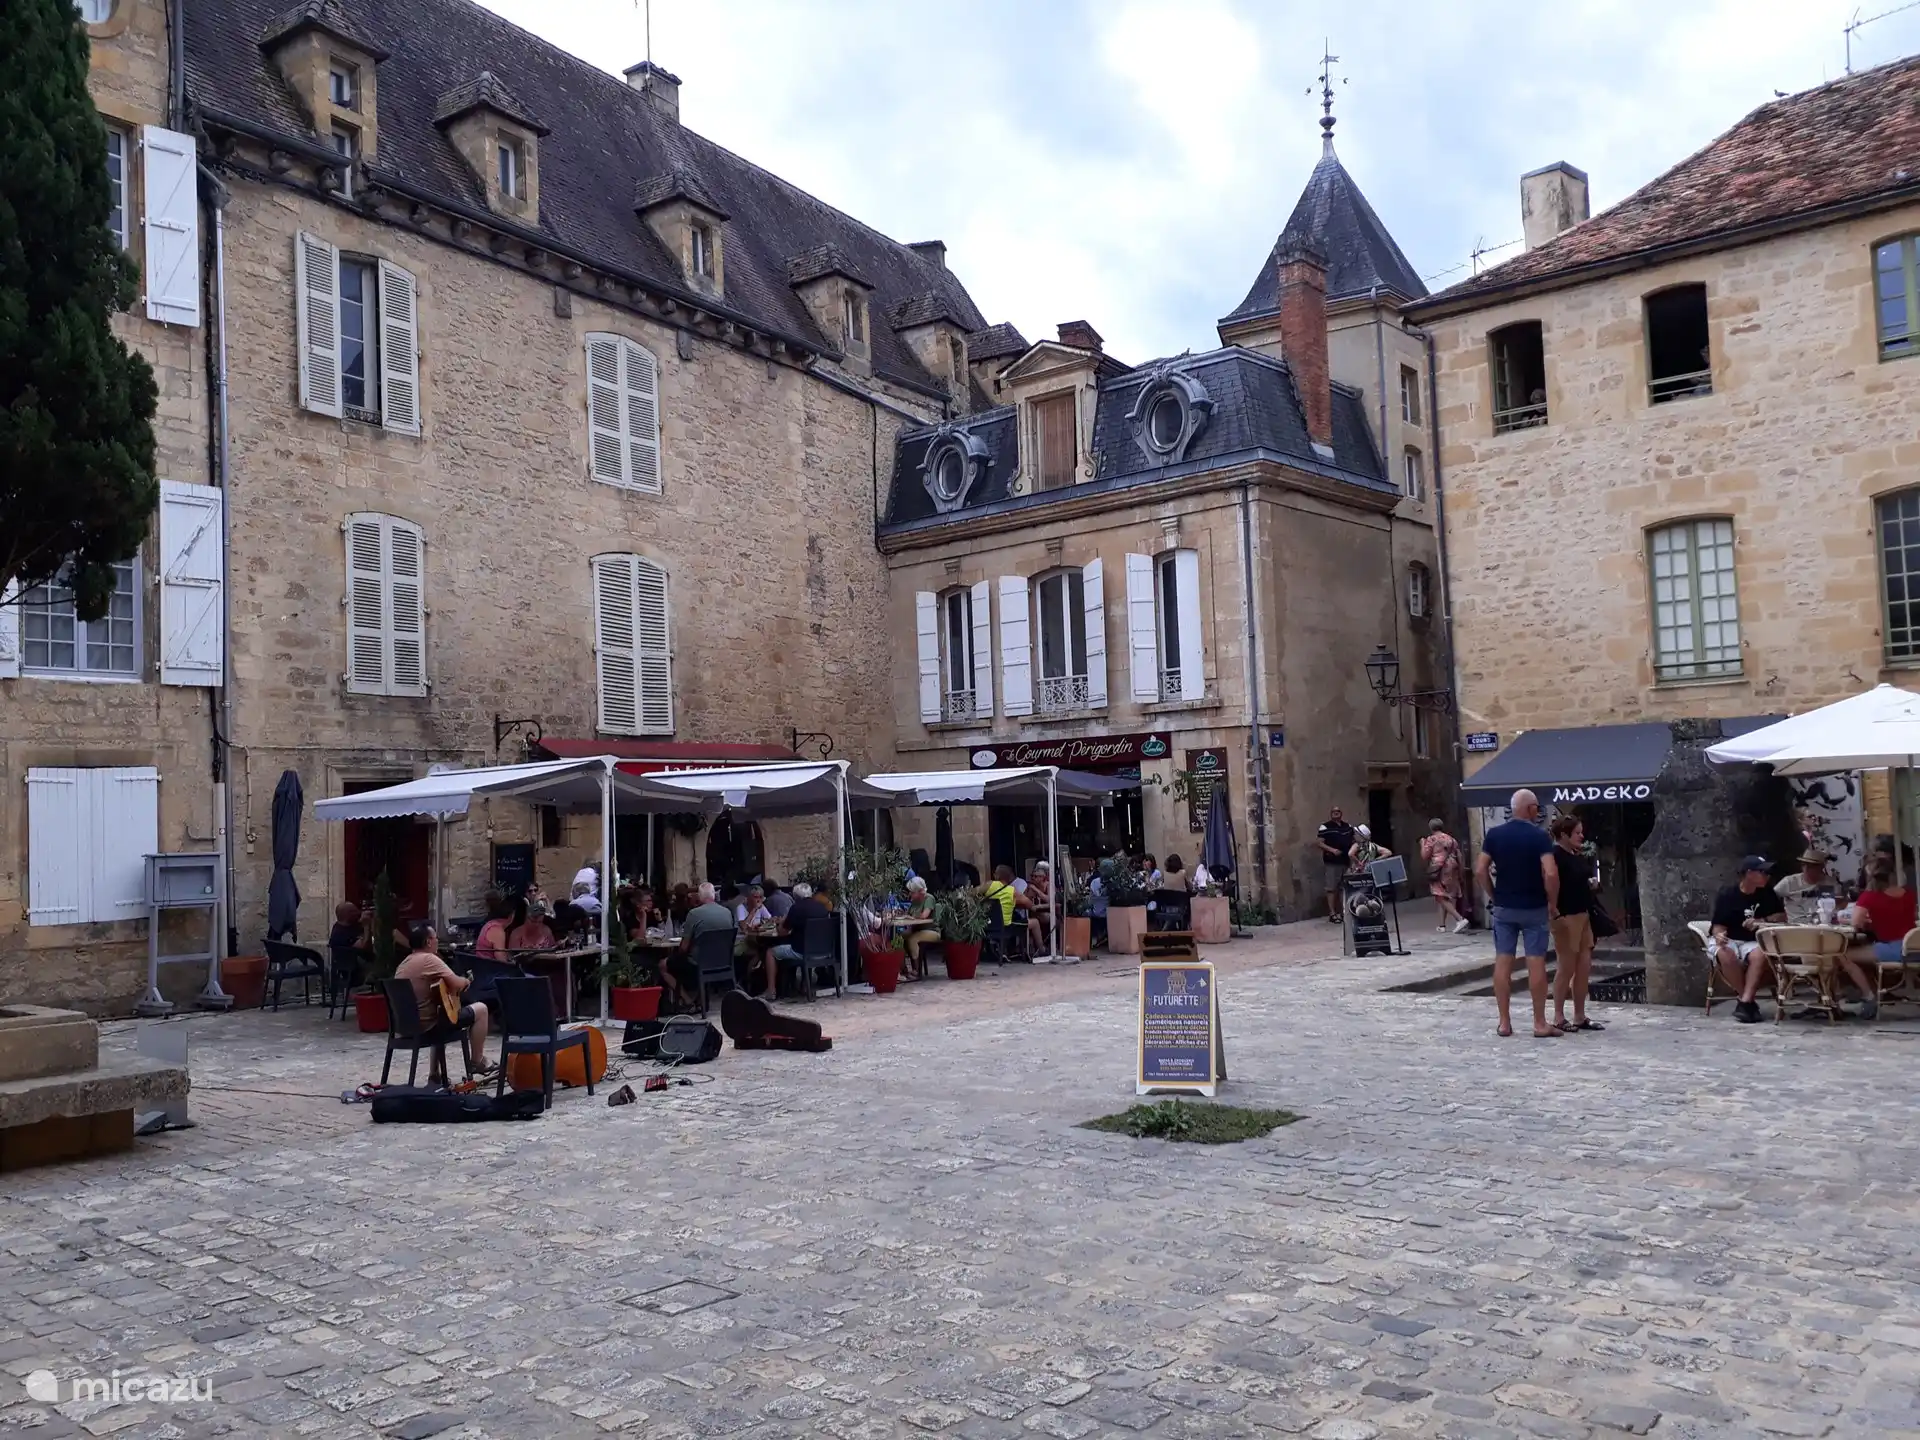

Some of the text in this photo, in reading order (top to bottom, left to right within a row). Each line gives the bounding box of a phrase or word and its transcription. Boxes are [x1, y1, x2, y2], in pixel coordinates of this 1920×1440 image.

[1015, 741, 1064, 766] Gourmet
[1553, 784, 1650, 802] MADEKO
[1153, 995, 1199, 1006] FUTURETTE
